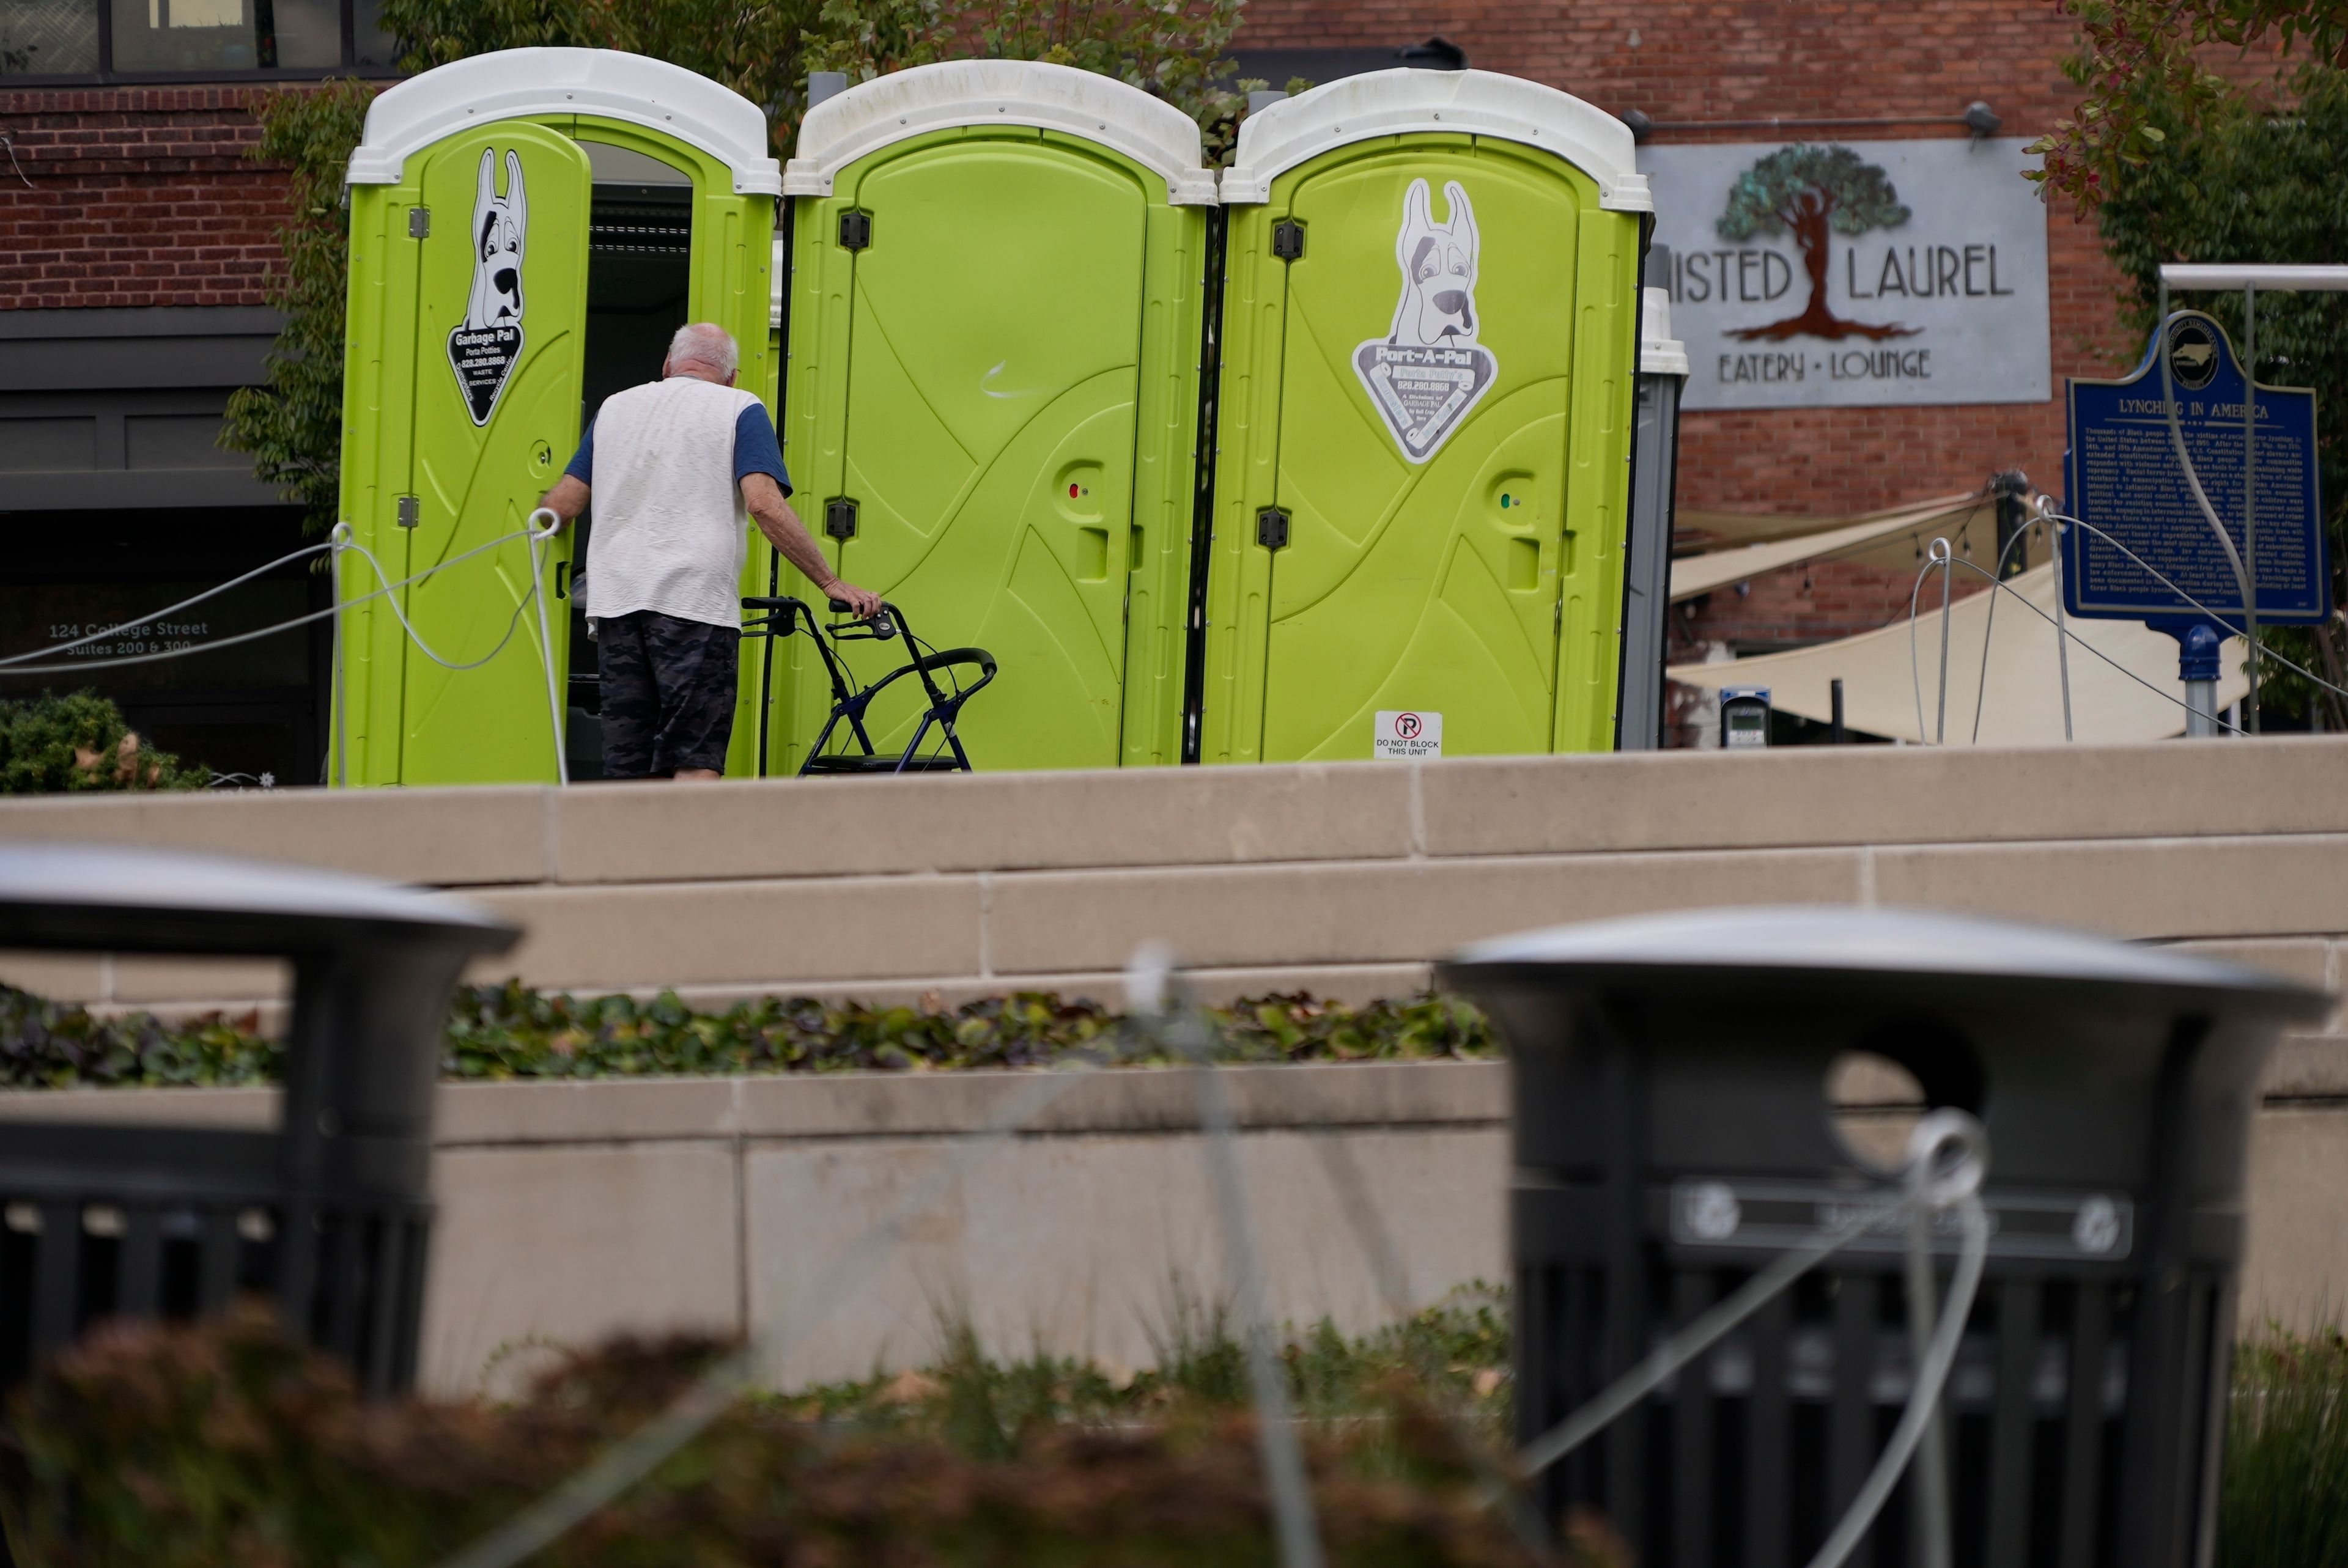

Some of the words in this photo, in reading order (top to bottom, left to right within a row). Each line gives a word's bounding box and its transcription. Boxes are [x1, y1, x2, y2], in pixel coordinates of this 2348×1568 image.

[1669, 249, 1793, 303] ISTED
[1847, 244, 2015, 299] LAUREL
[456, 333, 495, 346] Garbage
[497, 329, 514, 342] Pal
[481, 346, 501, 355] Potties
[1376, 347, 1472, 364] Port-A-Pal
[461, 356, 506, 368] 828.280.8868
[1719, 352, 1804, 383] EATERY
[1831, 349, 1932, 380] LOUNGE
[1400, 367, 1425, 377] Porta
[456, 363, 474, 402] Dumpsters
[489, 377, 503, 402] Recycle
[1398, 380, 1449, 391] 828.280.8868
[2119, 399, 2184, 416] LYNCHIG
[2191, 402, 2204, 416] IN
[2211, 403, 2269, 419] AMERCA
[49, 624, 79, 638] 124
[157, 622, 209, 635] Street
[67, 643, 112, 655] Suites
[117, 642, 144, 654] 200
[149, 641, 159, 652] &
[164, 641, 191, 652] 300
